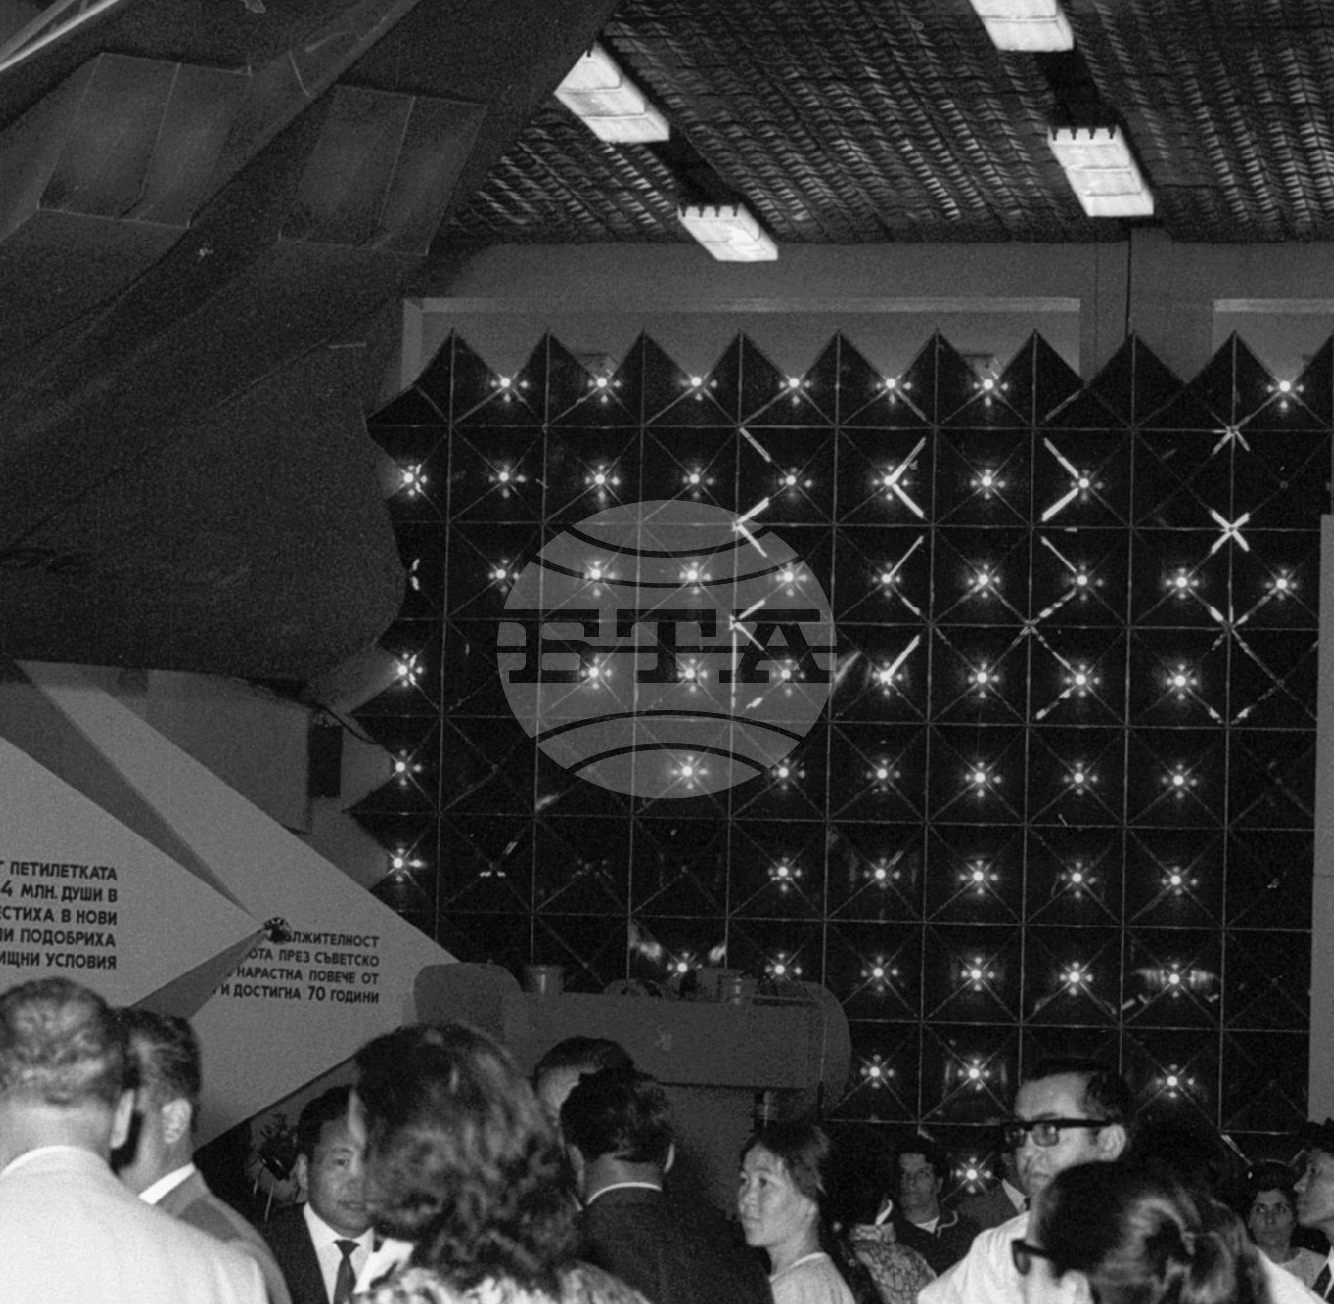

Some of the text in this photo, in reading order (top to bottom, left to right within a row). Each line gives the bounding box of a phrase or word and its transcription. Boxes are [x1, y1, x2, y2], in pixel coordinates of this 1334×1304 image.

[10, 861, 117, 881] ПЕТИЛЕТКАТА
[20, 883, 58, 900] МЛН.
[61, 886, 104, 902] ДУШИ
[108, 888, 118, 902] В
[61, 909, 71, 923] В
[76, 910, 117, 926] НОВИ
[20, 928, 116, 947] ПОДОБРИХА
[46, 952, 117, 970] УСЛОВИЯ
[279, 949, 310, 963] ПРЕЗ
[314, 951, 380, 967] СЪВЕТСКО
[237, 966, 303, 981] НАРАСТНА
[309, 970, 355, 984] ПОВЕЧЕ
[361, 973, 379, 985] ОТ
[233, 983, 301, 999] ДОСТИГНА
[307, 985, 326, 1000] 70
[330, 989, 380, 1004] ГОДИНИ
